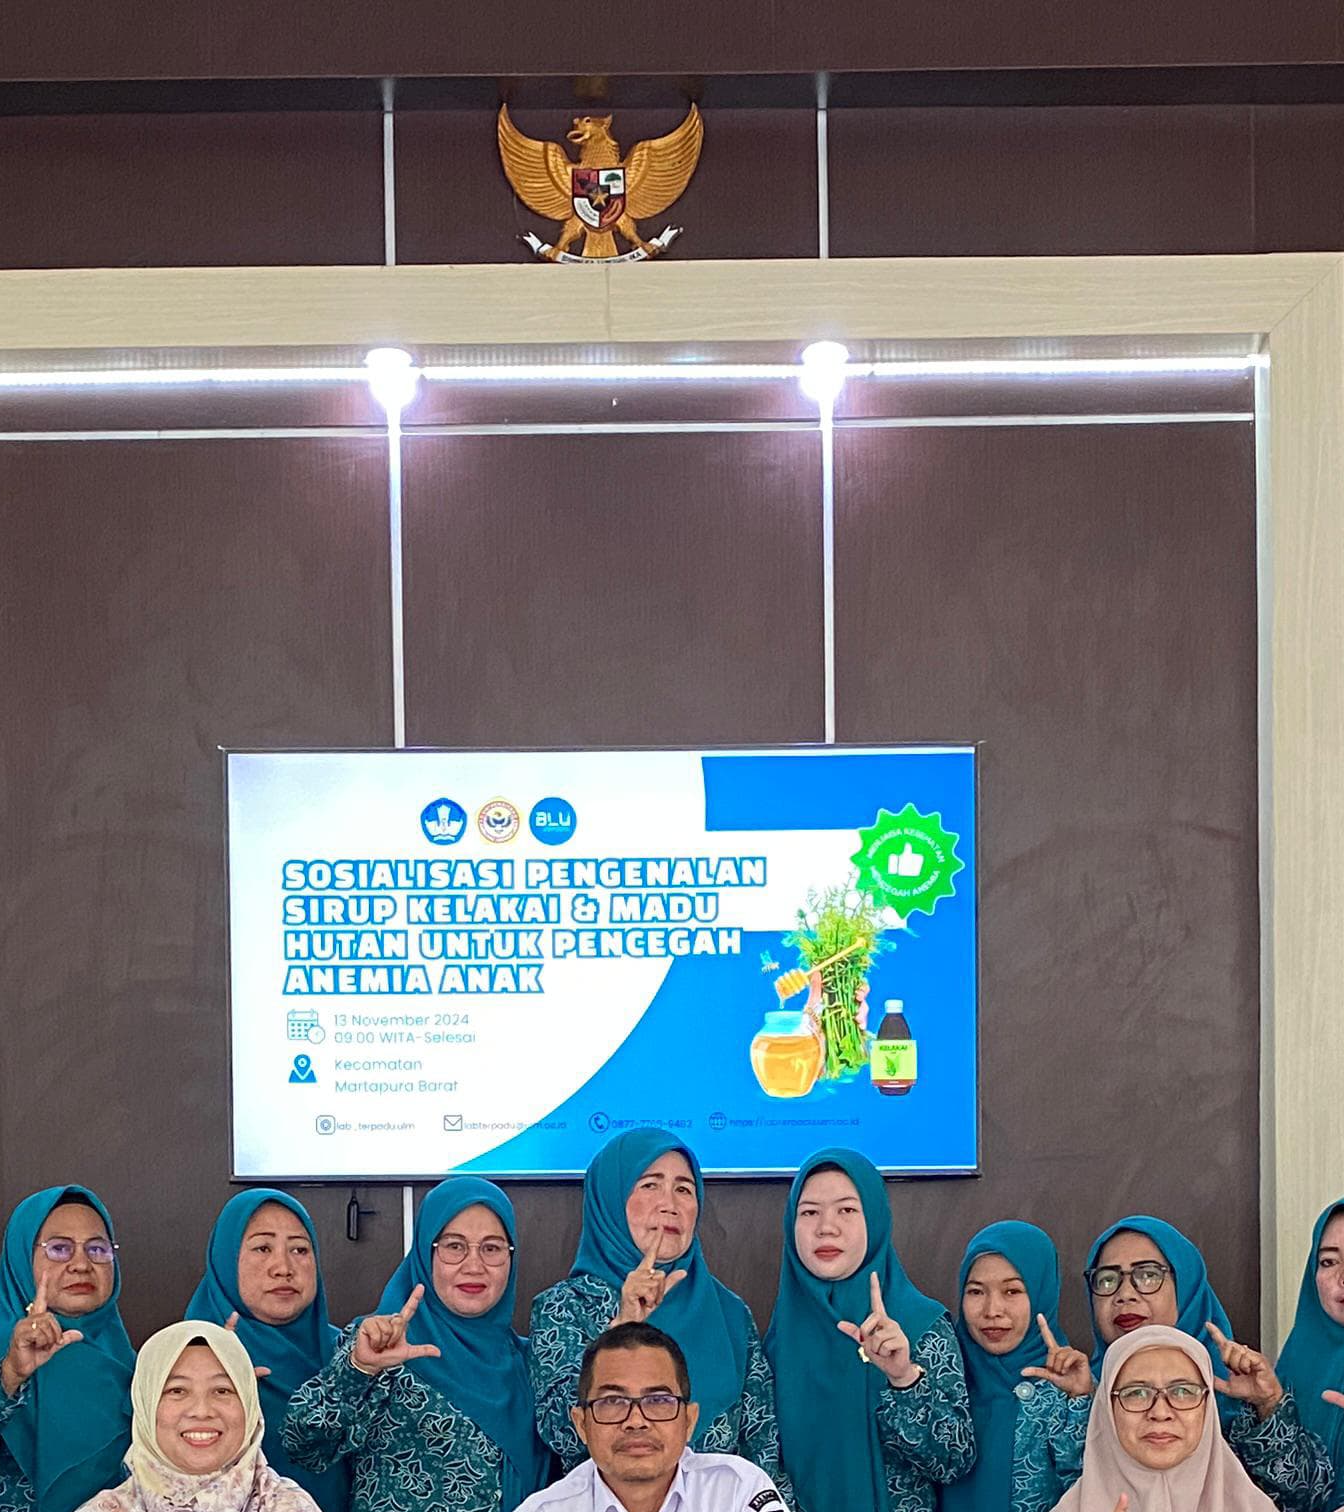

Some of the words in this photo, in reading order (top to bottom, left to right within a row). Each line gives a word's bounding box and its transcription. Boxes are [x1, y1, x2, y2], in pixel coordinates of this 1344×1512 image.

[535, 811, 571, 827] BLU
[282, 859, 515, 890] SOSIALISASI
[525, 857, 767, 889] PENGENALAN
[282, 895, 397, 925] SIRUP
[406, 893, 561, 925] KELAKAI
[571, 893, 601, 924] &
[609, 892, 719, 924] MADU
[284, 930, 409, 960] HUTAN
[418, 929, 544, 960] UNTUK
[552, 927, 744, 959] PENCEGAH
[282, 965, 433, 996] ANEMIA
[437, 963, 545, 995] ANAK
[334, 1014, 348, 1027] 13
[352, 1013, 430, 1027] November
[434, 1013, 470, 1027] 2024
[334, 1059, 423, 1072] Kecamatan
[334, 1080, 414, 1096] Martapura
[418, 1080, 459, 1093] Barat
